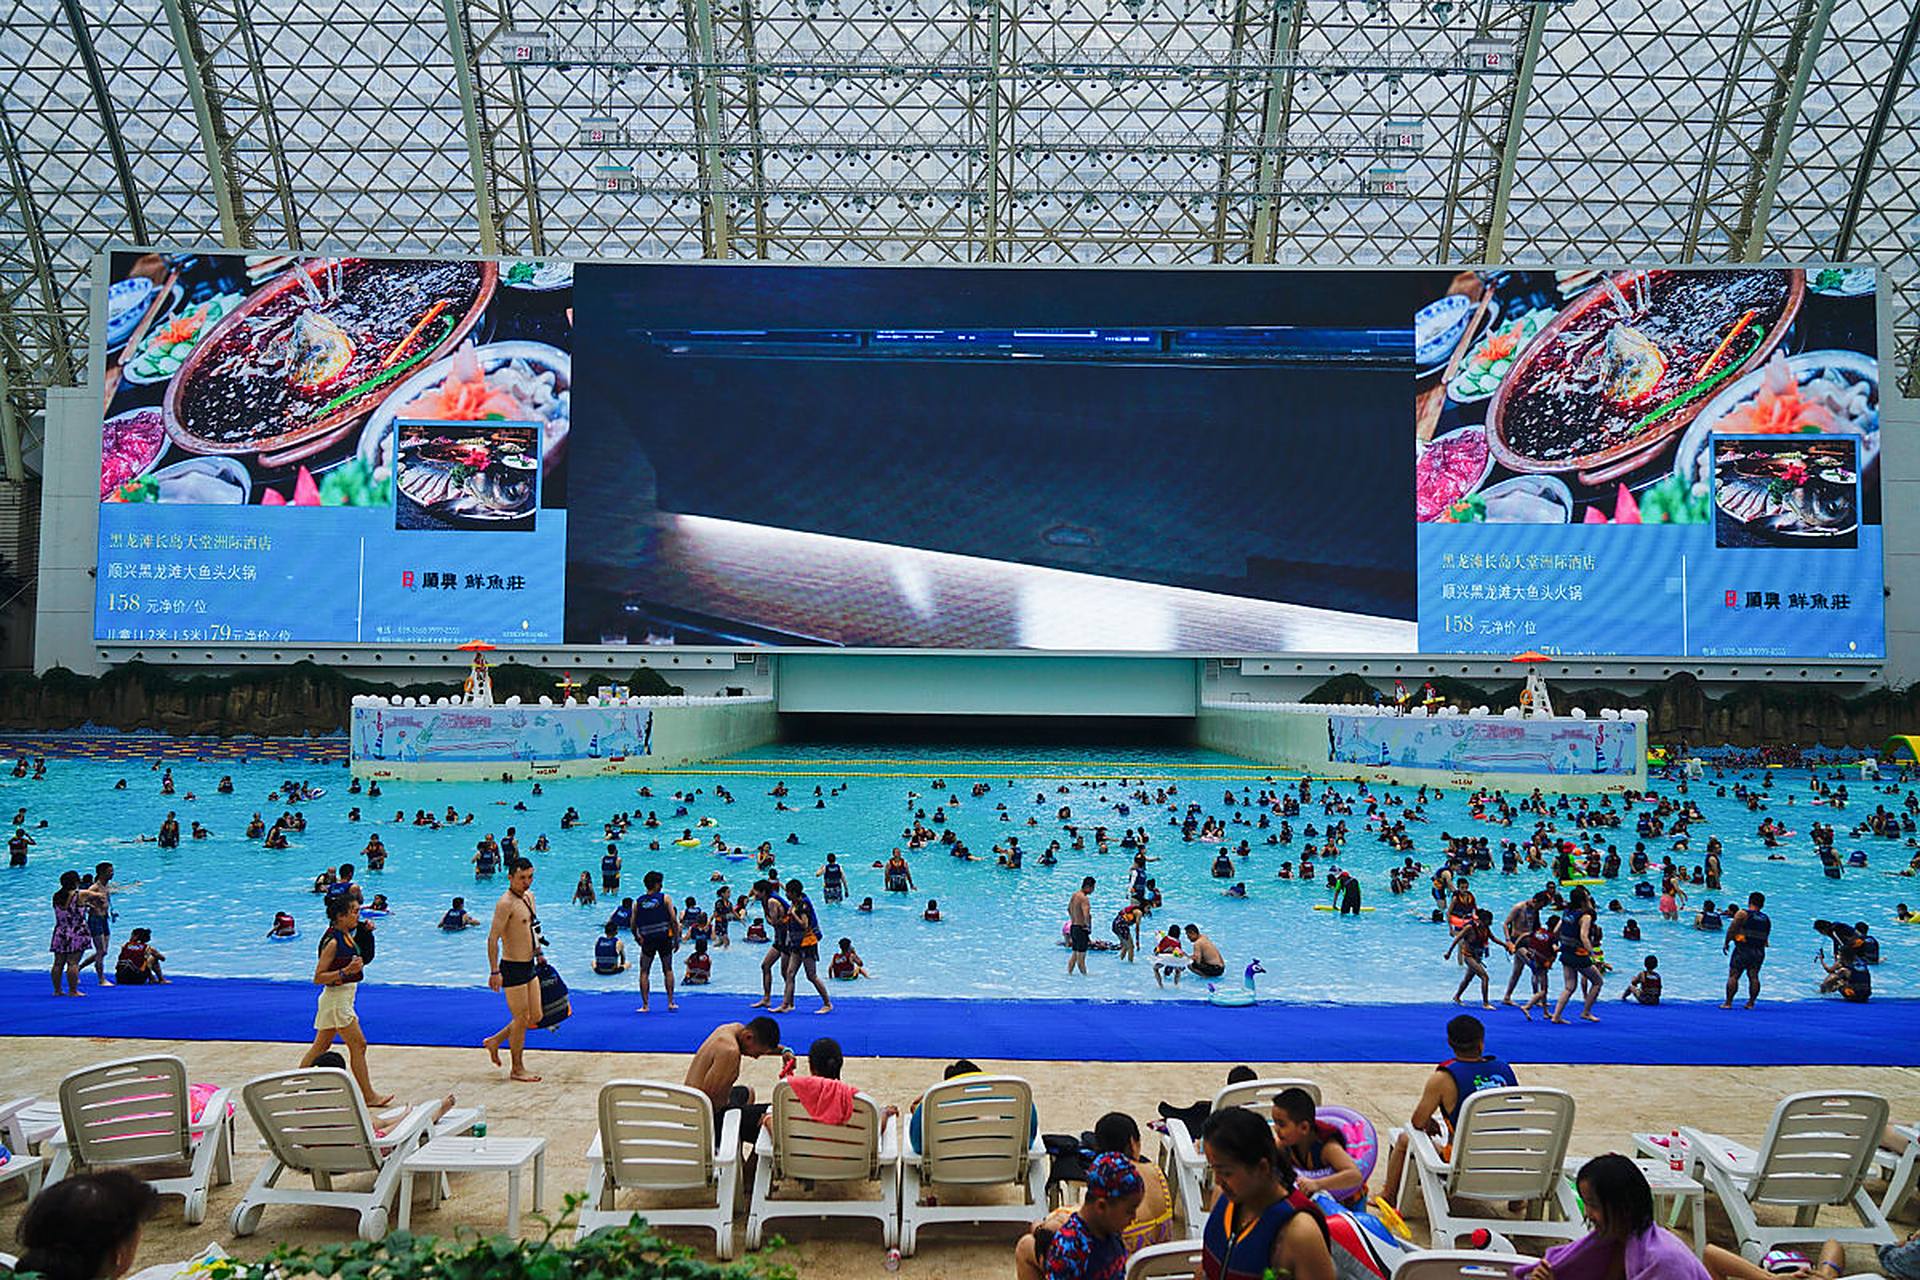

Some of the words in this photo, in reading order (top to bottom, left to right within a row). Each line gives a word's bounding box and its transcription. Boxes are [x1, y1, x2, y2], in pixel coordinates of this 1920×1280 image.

[517, 47, 529, 57] 21
[1487, 54, 1499, 65] 22
[1401, 135, 1411, 144] 24
[109, 533, 272, 551] 黑龙滩长岛天堂洲际酒店
[1442, 553, 1595, 570] 黑龙滩长岛天堂洲际酒店
[108, 562, 257, 581] 顺兴黑龙滩大鱼头火锅
[1442, 583, 1583, 601] 顺兴黑龙滩大鱼头火锅
[108, 592, 141, 612] 158
[146, 599, 208, 614] 元净价/位
[1444, 614, 1474, 633] 158
[1479, 620, 1537, 635] 元净价/位
